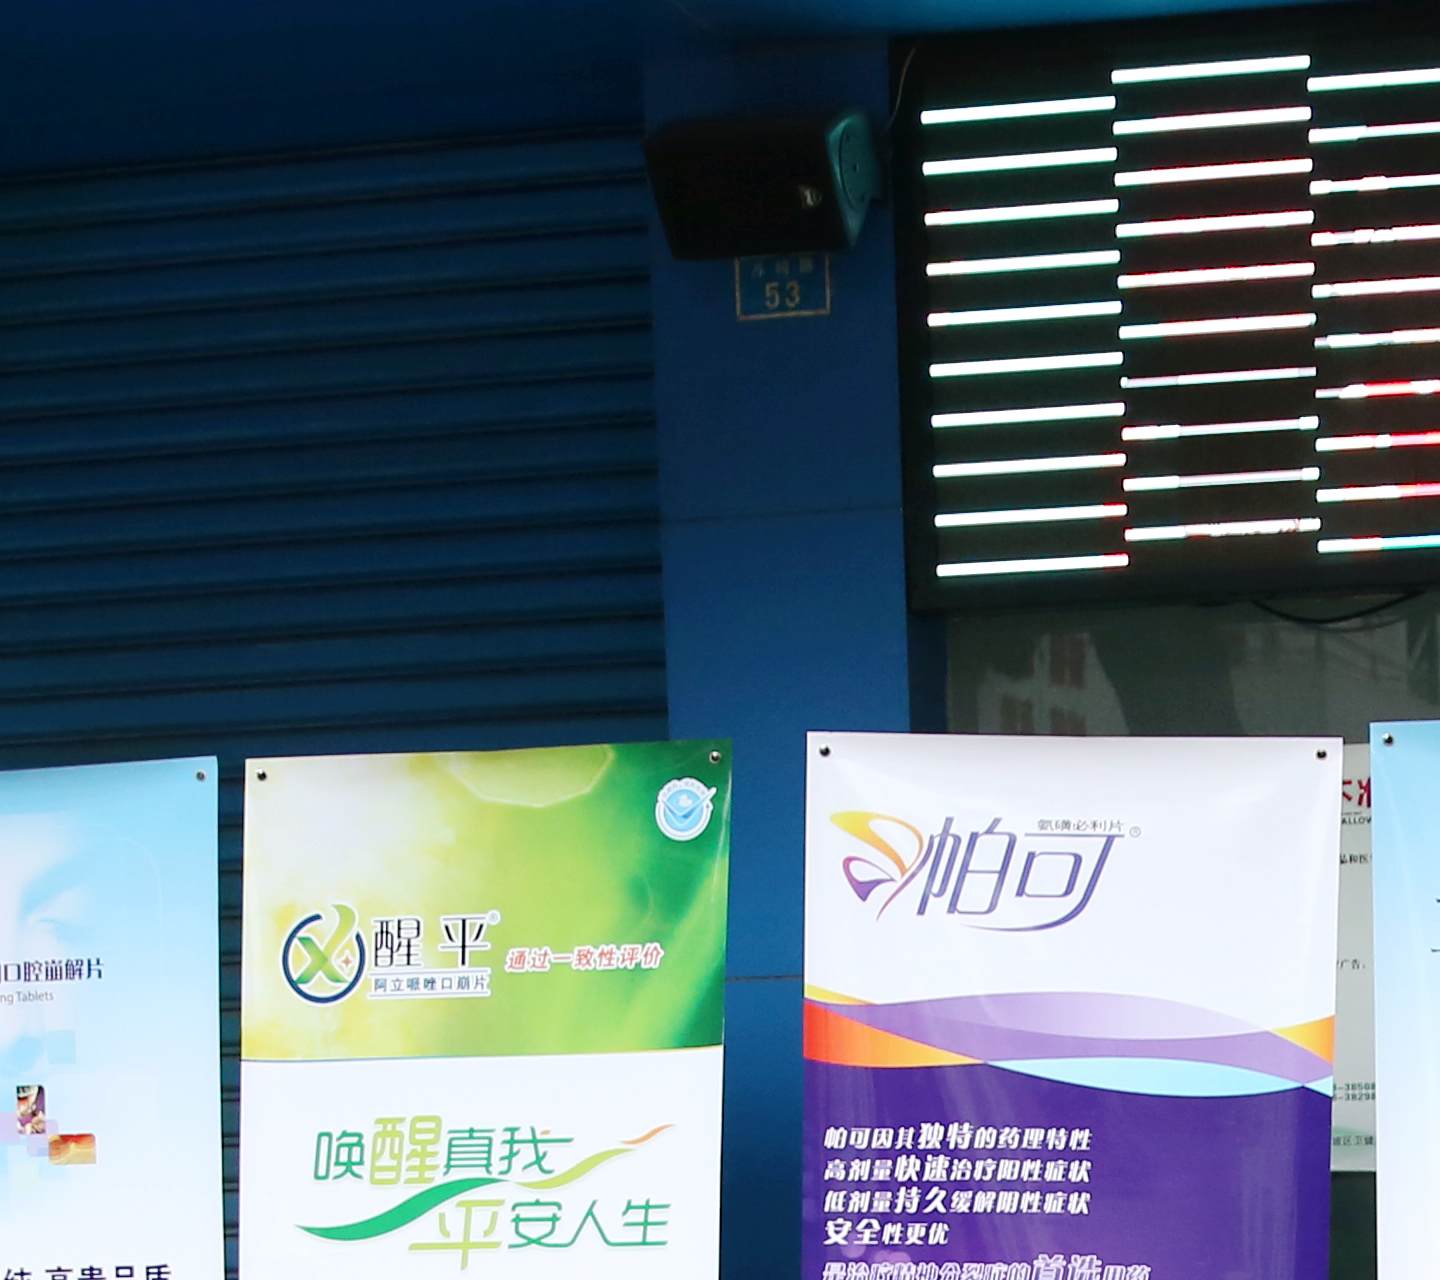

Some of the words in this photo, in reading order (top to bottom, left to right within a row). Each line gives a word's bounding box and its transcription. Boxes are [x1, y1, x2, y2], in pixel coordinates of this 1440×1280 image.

[764, 281, 801, 310] 53
[916, 815, 1125, 932] 帕可
[373, 917, 490, 968] 醒平
[506, 944, 663, 970] 通过一致性评价
[16, 990, 54, 1003] Tablets
[312, 1114, 575, 1186] 唤醒真我
[823, 1121, 1093, 1151] 帕可因其独特的药理特性
[823, 1153, 1093, 1184] 高剂量快速治疗阳性症状
[823, 1186, 1092, 1215] 低剂量持久缓解阴性症状
[408, 1198, 672, 1271] 平安人生
[823, 1217, 950, 1246] 安全性更优
